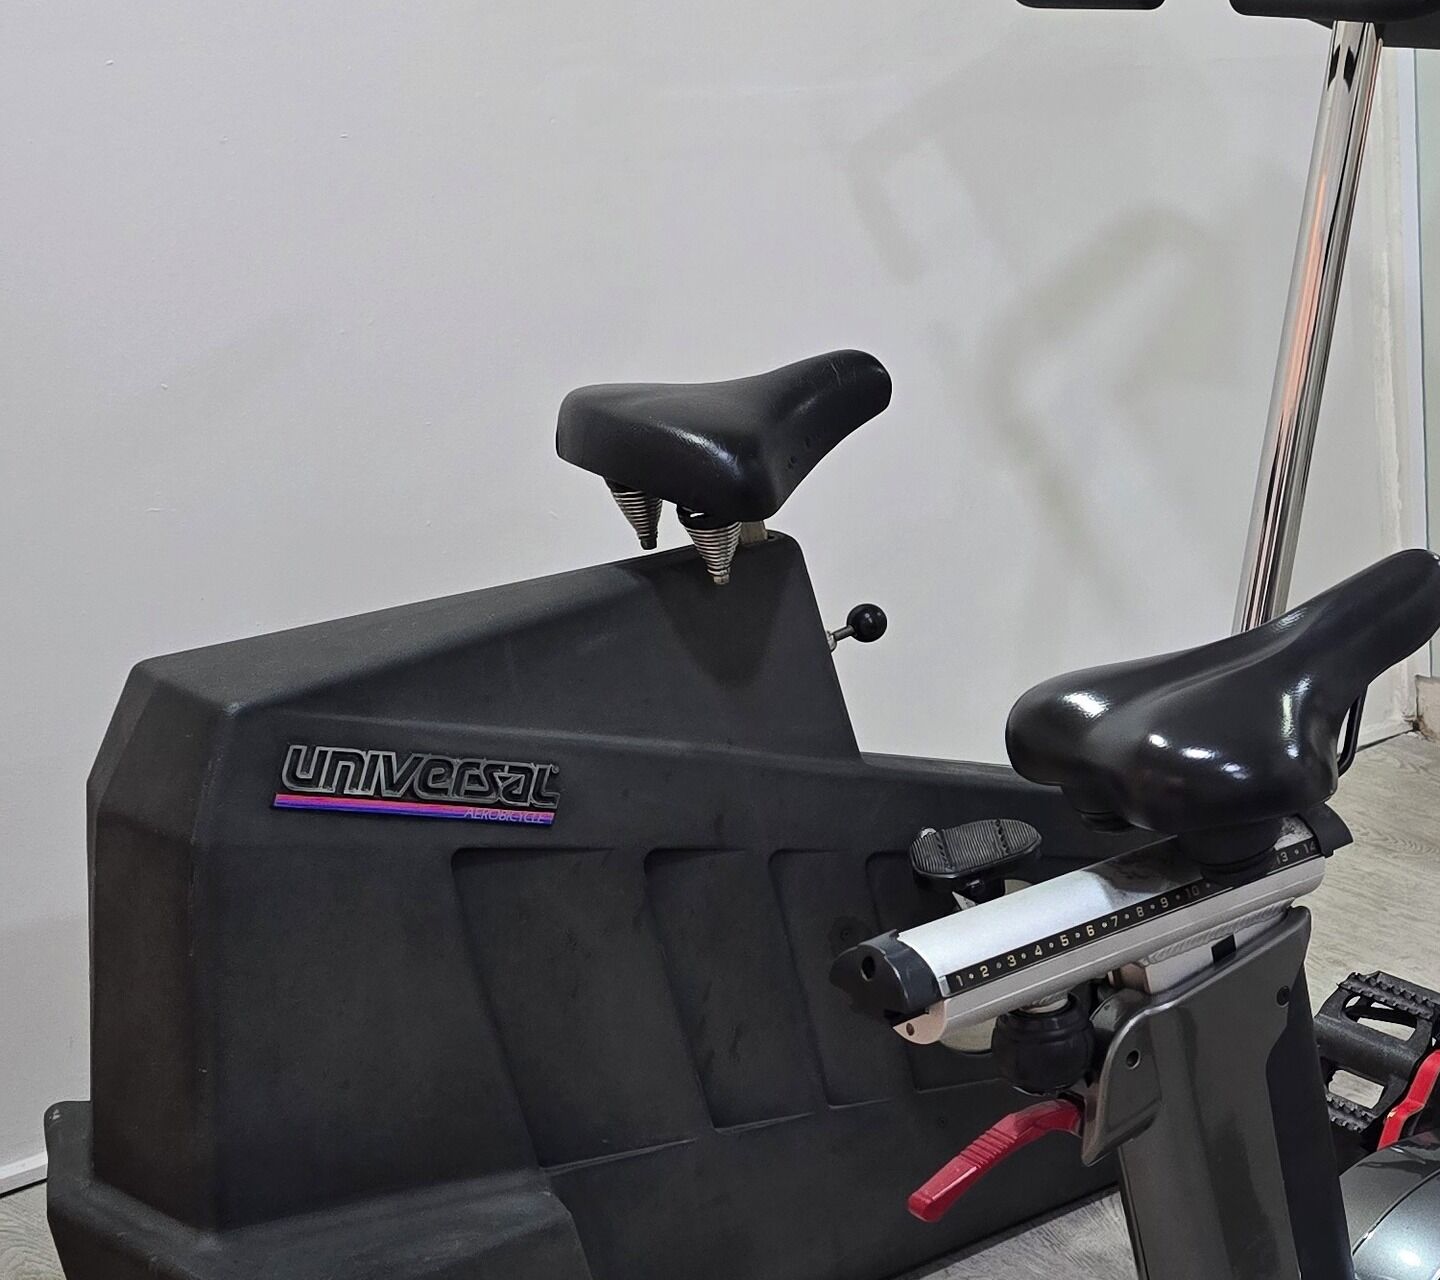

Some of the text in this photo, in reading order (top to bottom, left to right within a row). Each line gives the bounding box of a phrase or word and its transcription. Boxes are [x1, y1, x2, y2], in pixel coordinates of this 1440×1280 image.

[464, 808, 546, 824] AEROBICYCLE
[956, 975, 963, 987] 1
[980, 965, 989, 978] 2
[1007, 955, 1016, 967] 3
[1034, 945, 1043, 956] 4
[1060, 935, 1069, 946] 5
[1086, 925, 1095, 937] 6
[1110, 916, 1118, 927] 7
[1136, 907, 1144, 918] 8
[1160, 897, 1168, 908] 9
[1185, 886, 1200, 898] 10
